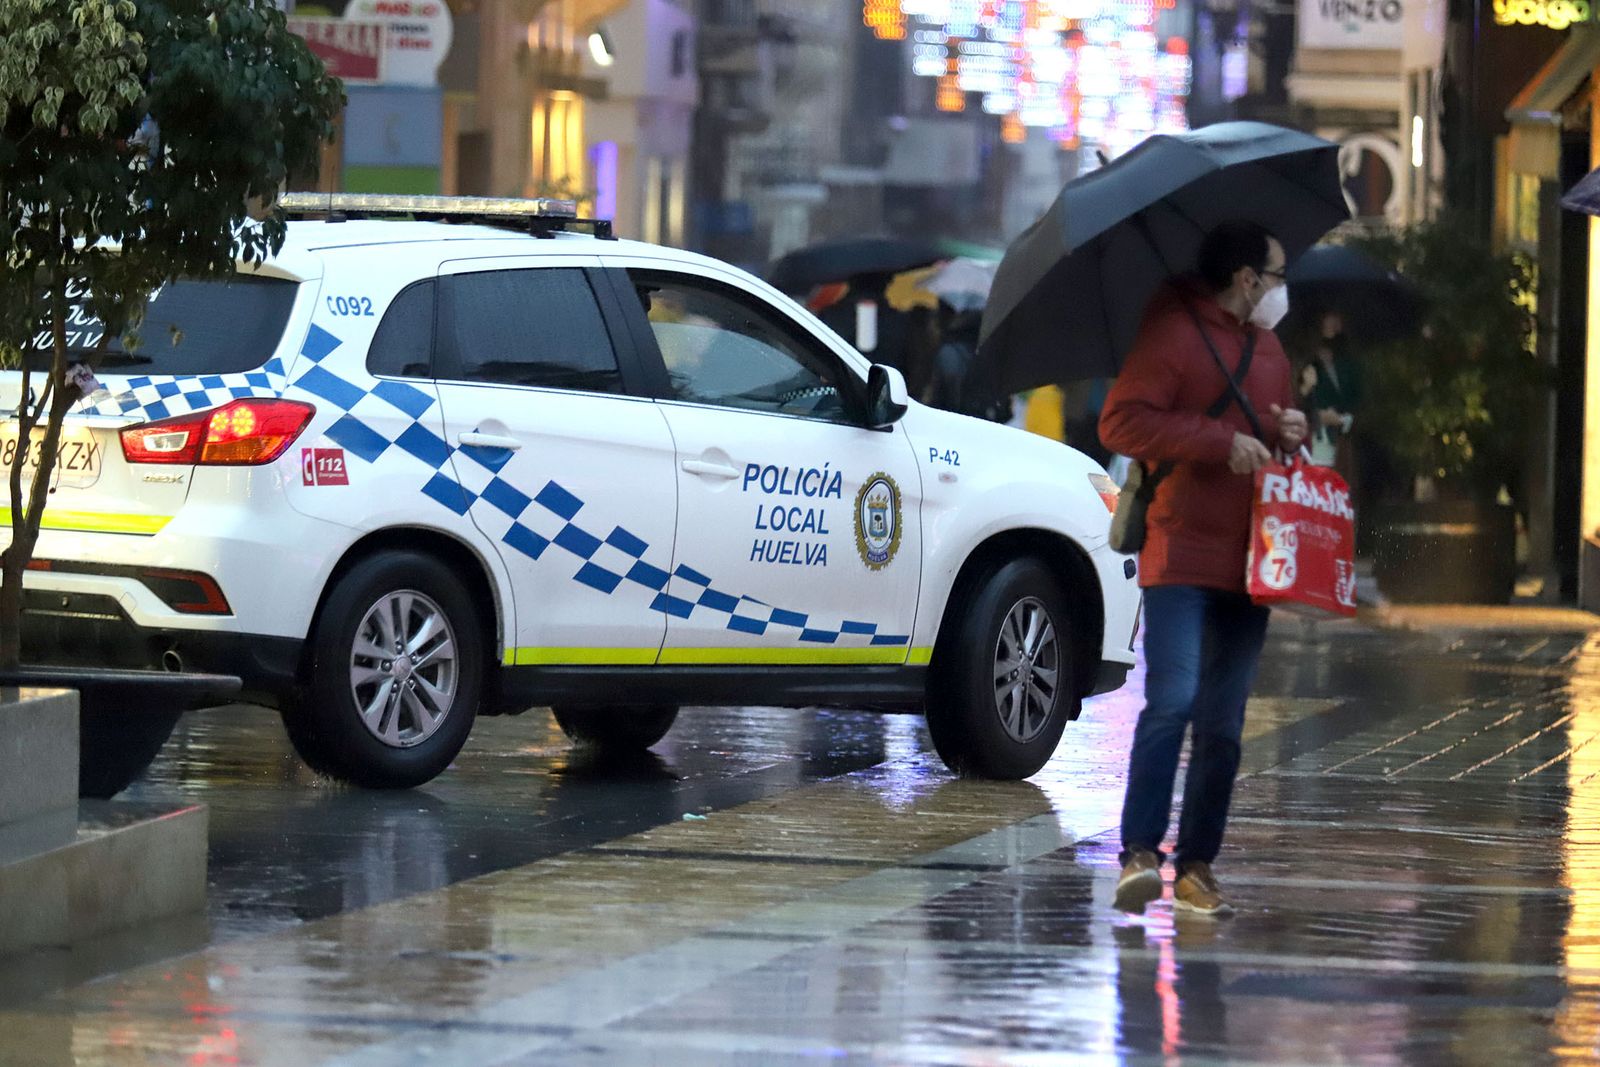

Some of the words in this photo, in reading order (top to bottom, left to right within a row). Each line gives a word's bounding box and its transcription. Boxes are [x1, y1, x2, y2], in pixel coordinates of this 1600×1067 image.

[326, 295, 375, 317] C092
[317, 457, 343, 472] 112
[929, 446, 961, 466] P-42
[742, 461, 842, 499] POLICÍA
[755, 504, 829, 534] LOCAL
[1280, 530, 1296, 547] 10
[750, 539, 827, 566] HUELVA
